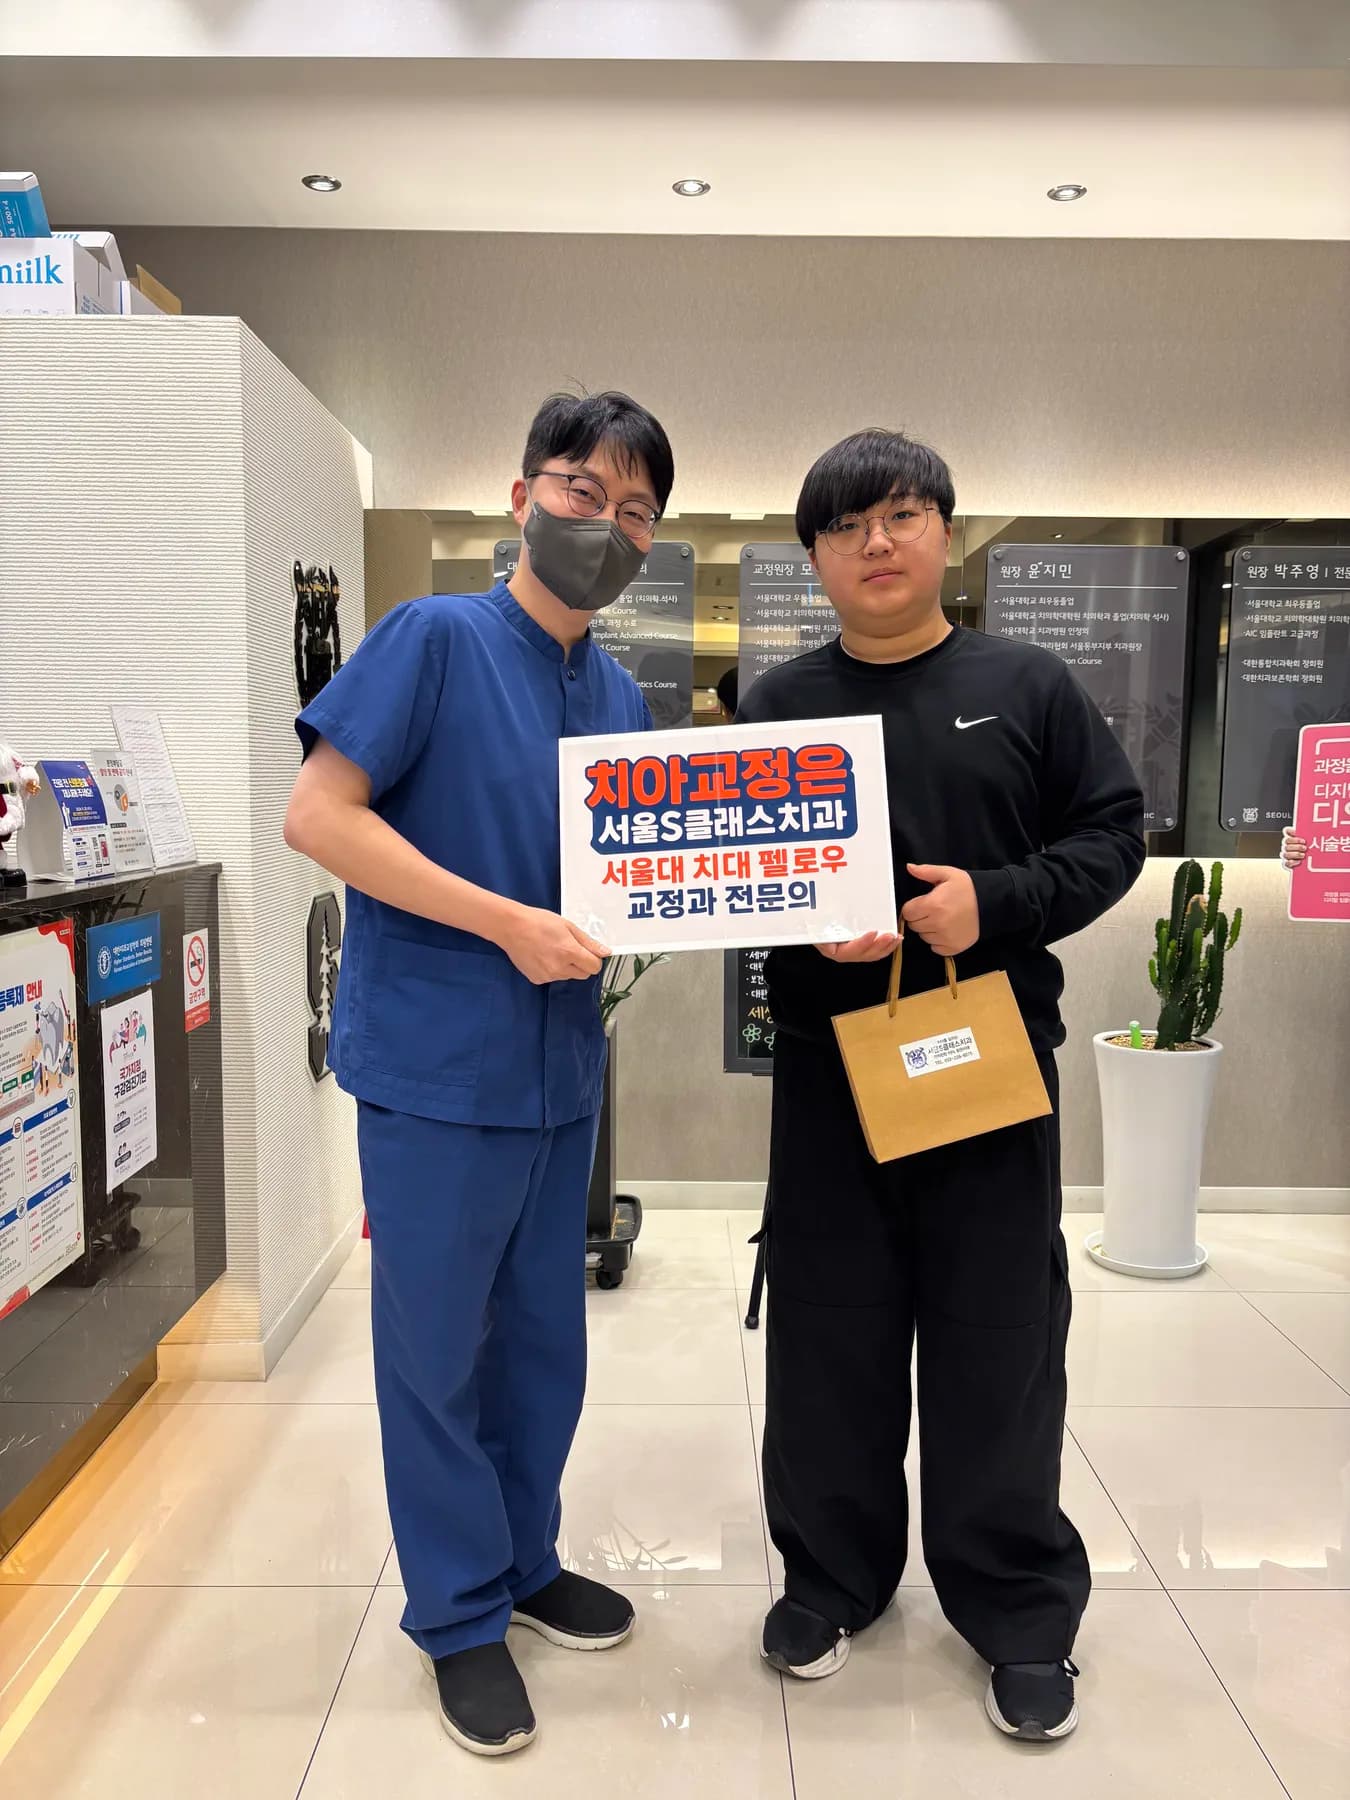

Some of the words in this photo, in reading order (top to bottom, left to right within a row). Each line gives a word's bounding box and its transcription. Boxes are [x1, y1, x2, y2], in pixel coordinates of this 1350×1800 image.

[752, 563, 794, 576] 교정원장
[1000, 565, 1022, 578] 원장
[1027, 563, 1072, 579] 윤지민
[1247, 565, 1268, 579] 원장
[1274, 563, 1319, 580] 박주영
[756, 594, 791, 603] 서울대학교
[1001, 597, 1037, 606] 서울대학교
[1038, 597, 1075, 606] 최우등졸업
[1247, 600, 1283, 609] 서울대학교
[1284, 600, 1321, 609] 최우등졸업
[612, 607, 638, 615] Course
[756, 609, 791, 618] 서울대학교
[1000, 612, 1036, 621] 서울대학교
[1038, 612, 1081, 621] 치의학대학원
[1246, 615, 1282, 624] 서울대학교
[1284, 615, 1327, 624] 치의학대학원
[756, 624, 791, 633] 서울대학교
[1000, 627, 1036, 636] 서울대학교
[1038, 627, 1066, 636] 치과병원
[592, 632, 618, 640] Implant
[620, 632, 653, 640] Advanced
[653, 632, 679, 640] Course
[1289, 630, 1319, 639] 고급과정
[606, 643, 631, 651] Course
[755, 640, 791, 648] 서울대학교
[755, 654, 790, 664] 서울대학교
[1077, 657, 1103, 665] Course
[654, 681, 678, 689] Course
[586, 744, 848, 809] 치아교정은
[1314, 782, 1350, 799] 디지
[1265, 811, 1292, 819] SEOUL
[598, 800, 848, 845] 서울S클래스치과
[602, 856, 684, 887] 서울대
[692, 851, 750, 881] 치대
[758, 845, 848, 876] 펠로우
[627, 888, 717, 919] 교정과
[725, 881, 817, 913] 전문의
[26, 979, 43, 1002] 안내
[119, 1059, 141, 1080] 국가지정
[114, 1069, 147, 1099] 구강검진기관
